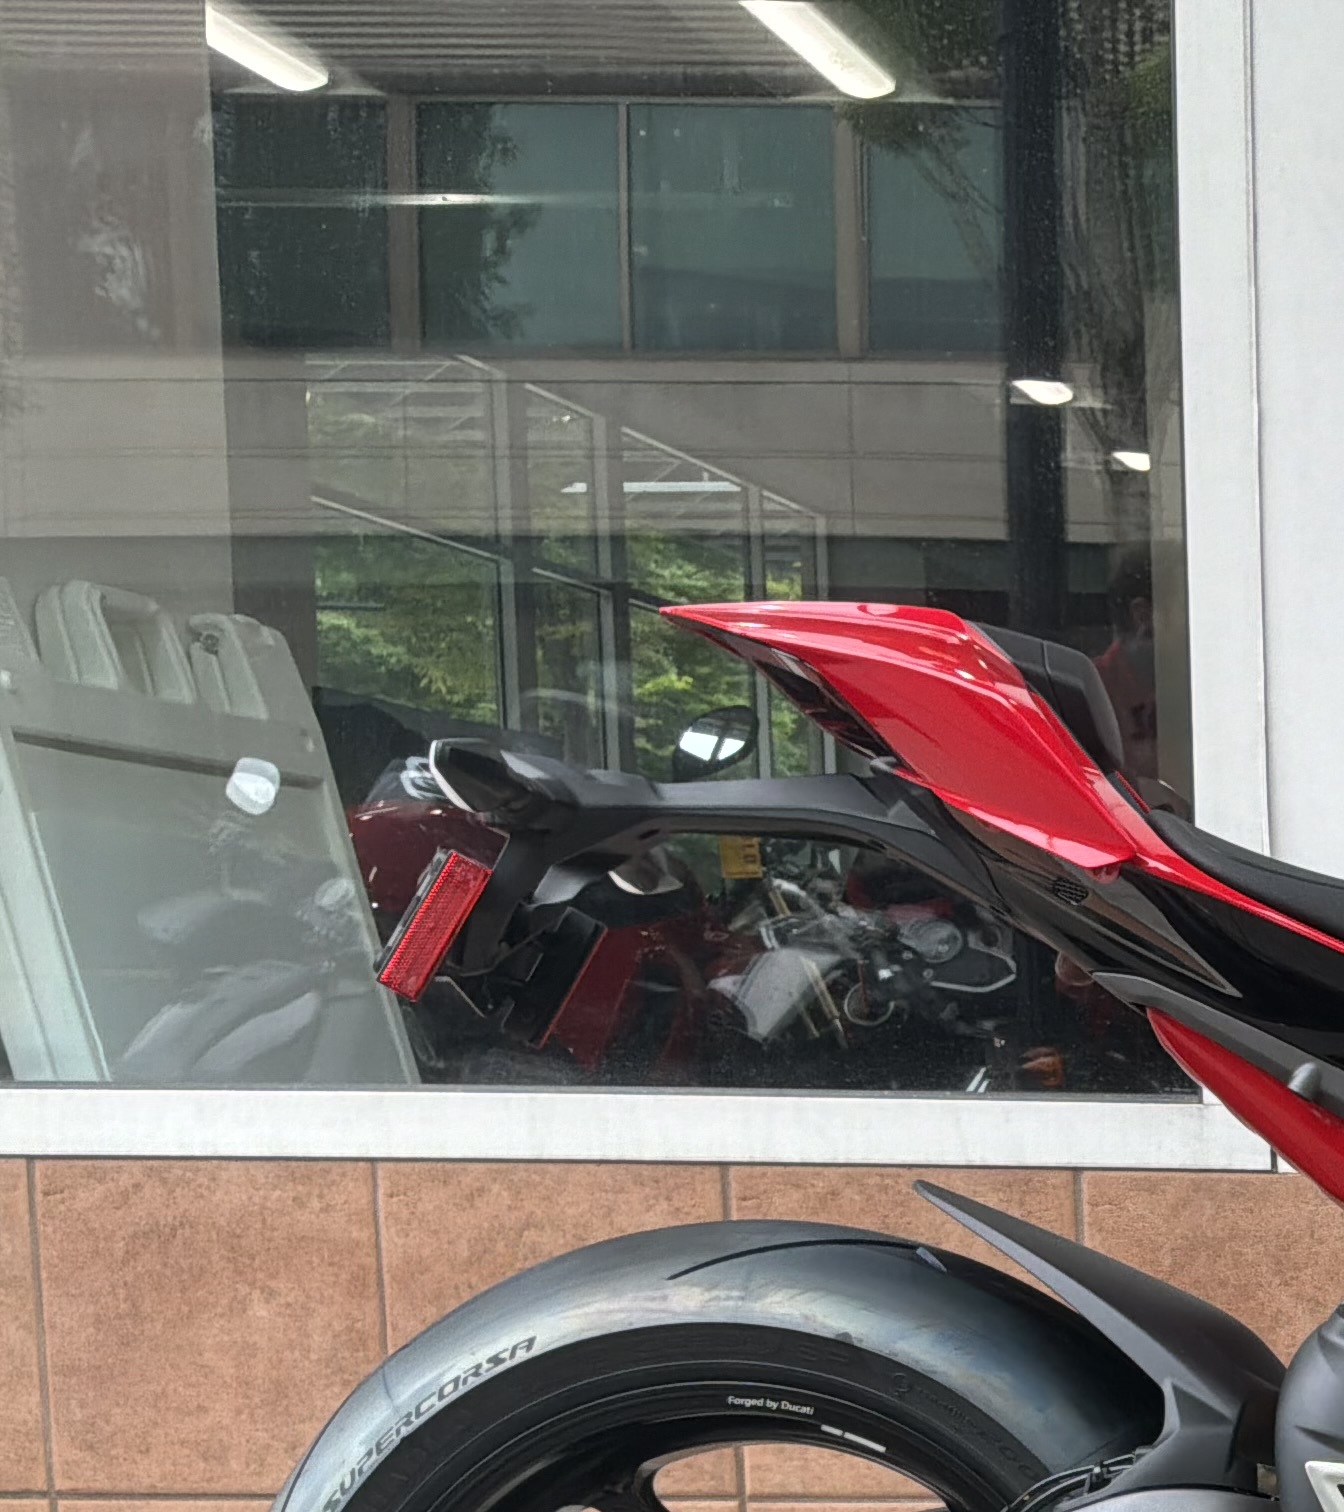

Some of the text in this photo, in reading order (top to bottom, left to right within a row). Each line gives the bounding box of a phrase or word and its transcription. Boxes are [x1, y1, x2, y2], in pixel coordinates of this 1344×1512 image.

[728, 1396, 815, 1416] Forged by Ducati
